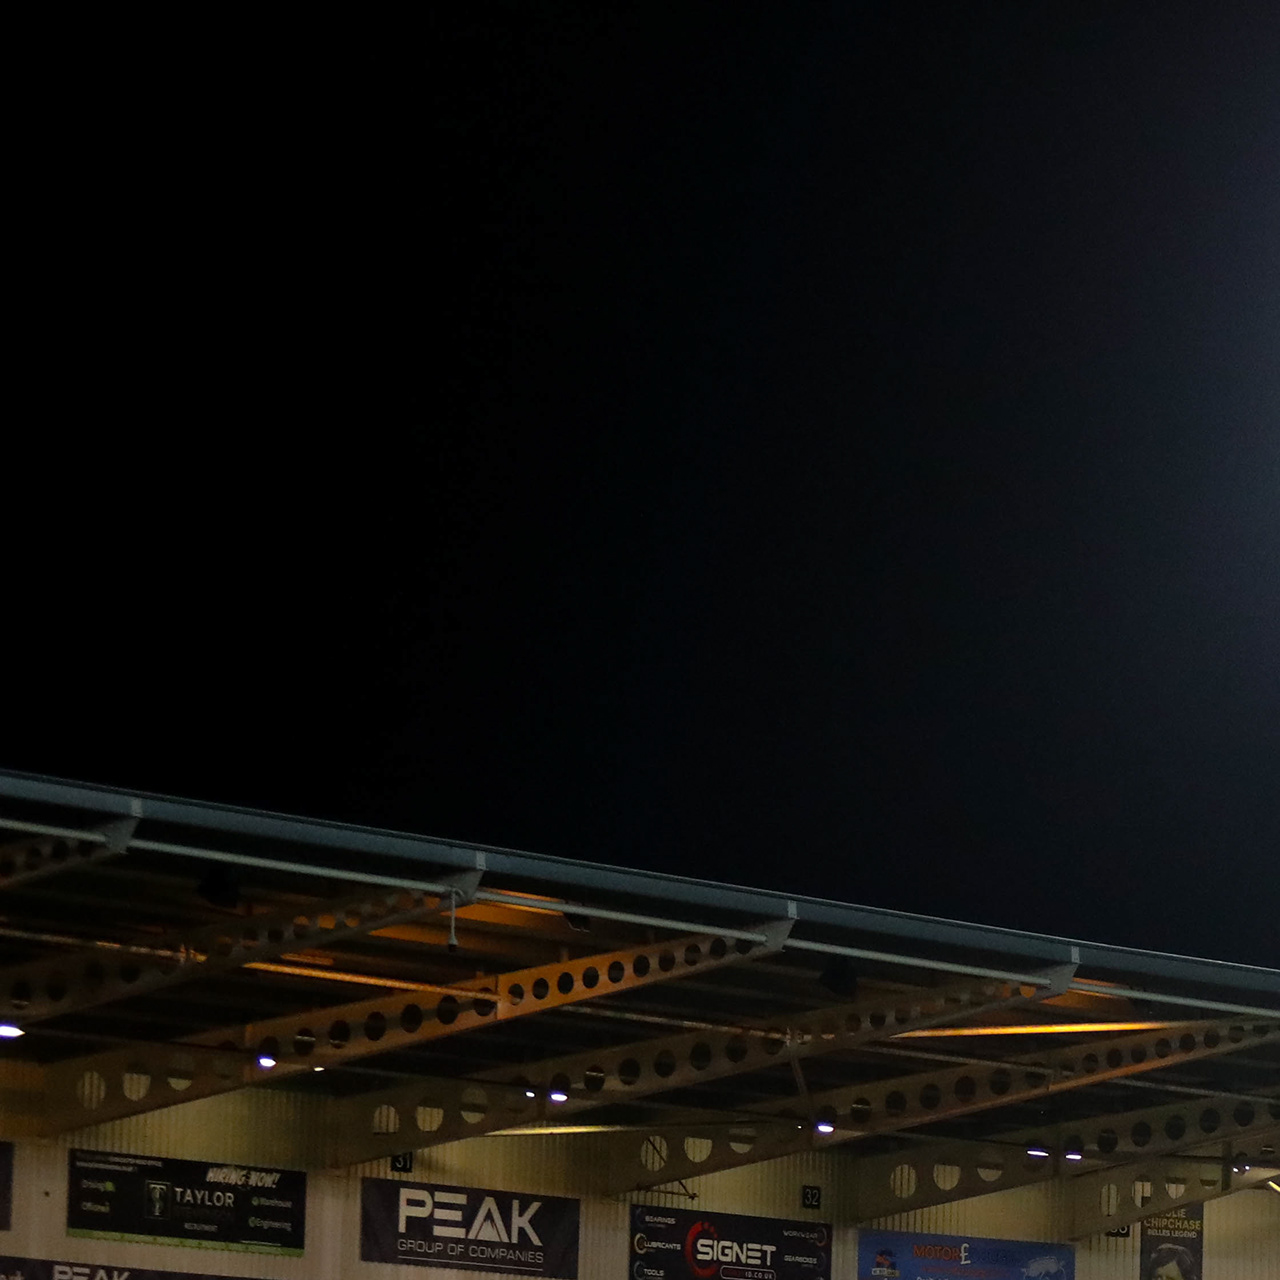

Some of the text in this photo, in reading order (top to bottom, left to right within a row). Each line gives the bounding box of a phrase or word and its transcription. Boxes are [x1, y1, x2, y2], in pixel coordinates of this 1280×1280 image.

[173, 1187, 235, 1208] TAYLOR
[804, 1188, 820, 1206] 32
[398, 1187, 544, 1247] PEAK
[1143, 1217, 1201, 1231] CHIPCHASE
[1171, 1230, 1198, 1239] LEGEND
[397, 1238, 545, 1264] GROUP OF COMPANIES
[696, 1238, 778, 1267] SIGNET
